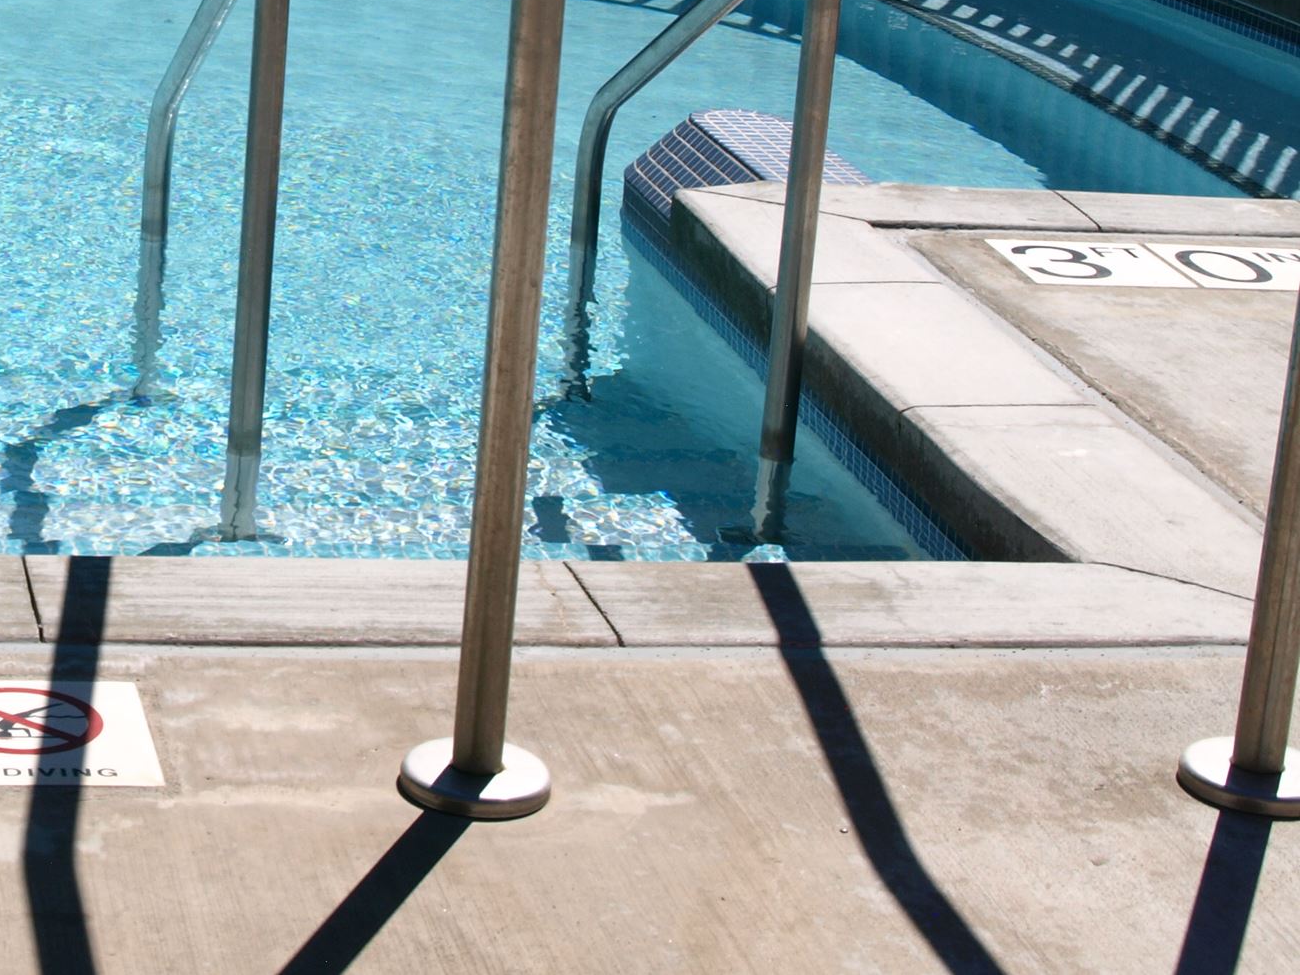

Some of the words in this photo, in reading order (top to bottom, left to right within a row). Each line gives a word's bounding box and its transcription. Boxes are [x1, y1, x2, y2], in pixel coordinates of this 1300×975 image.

[1011, 245, 1113, 279] 3
[1089, 246, 1140, 259] FT
[1174, 250, 1273, 283] 0
[3, 767, 118, 778] DIVING
